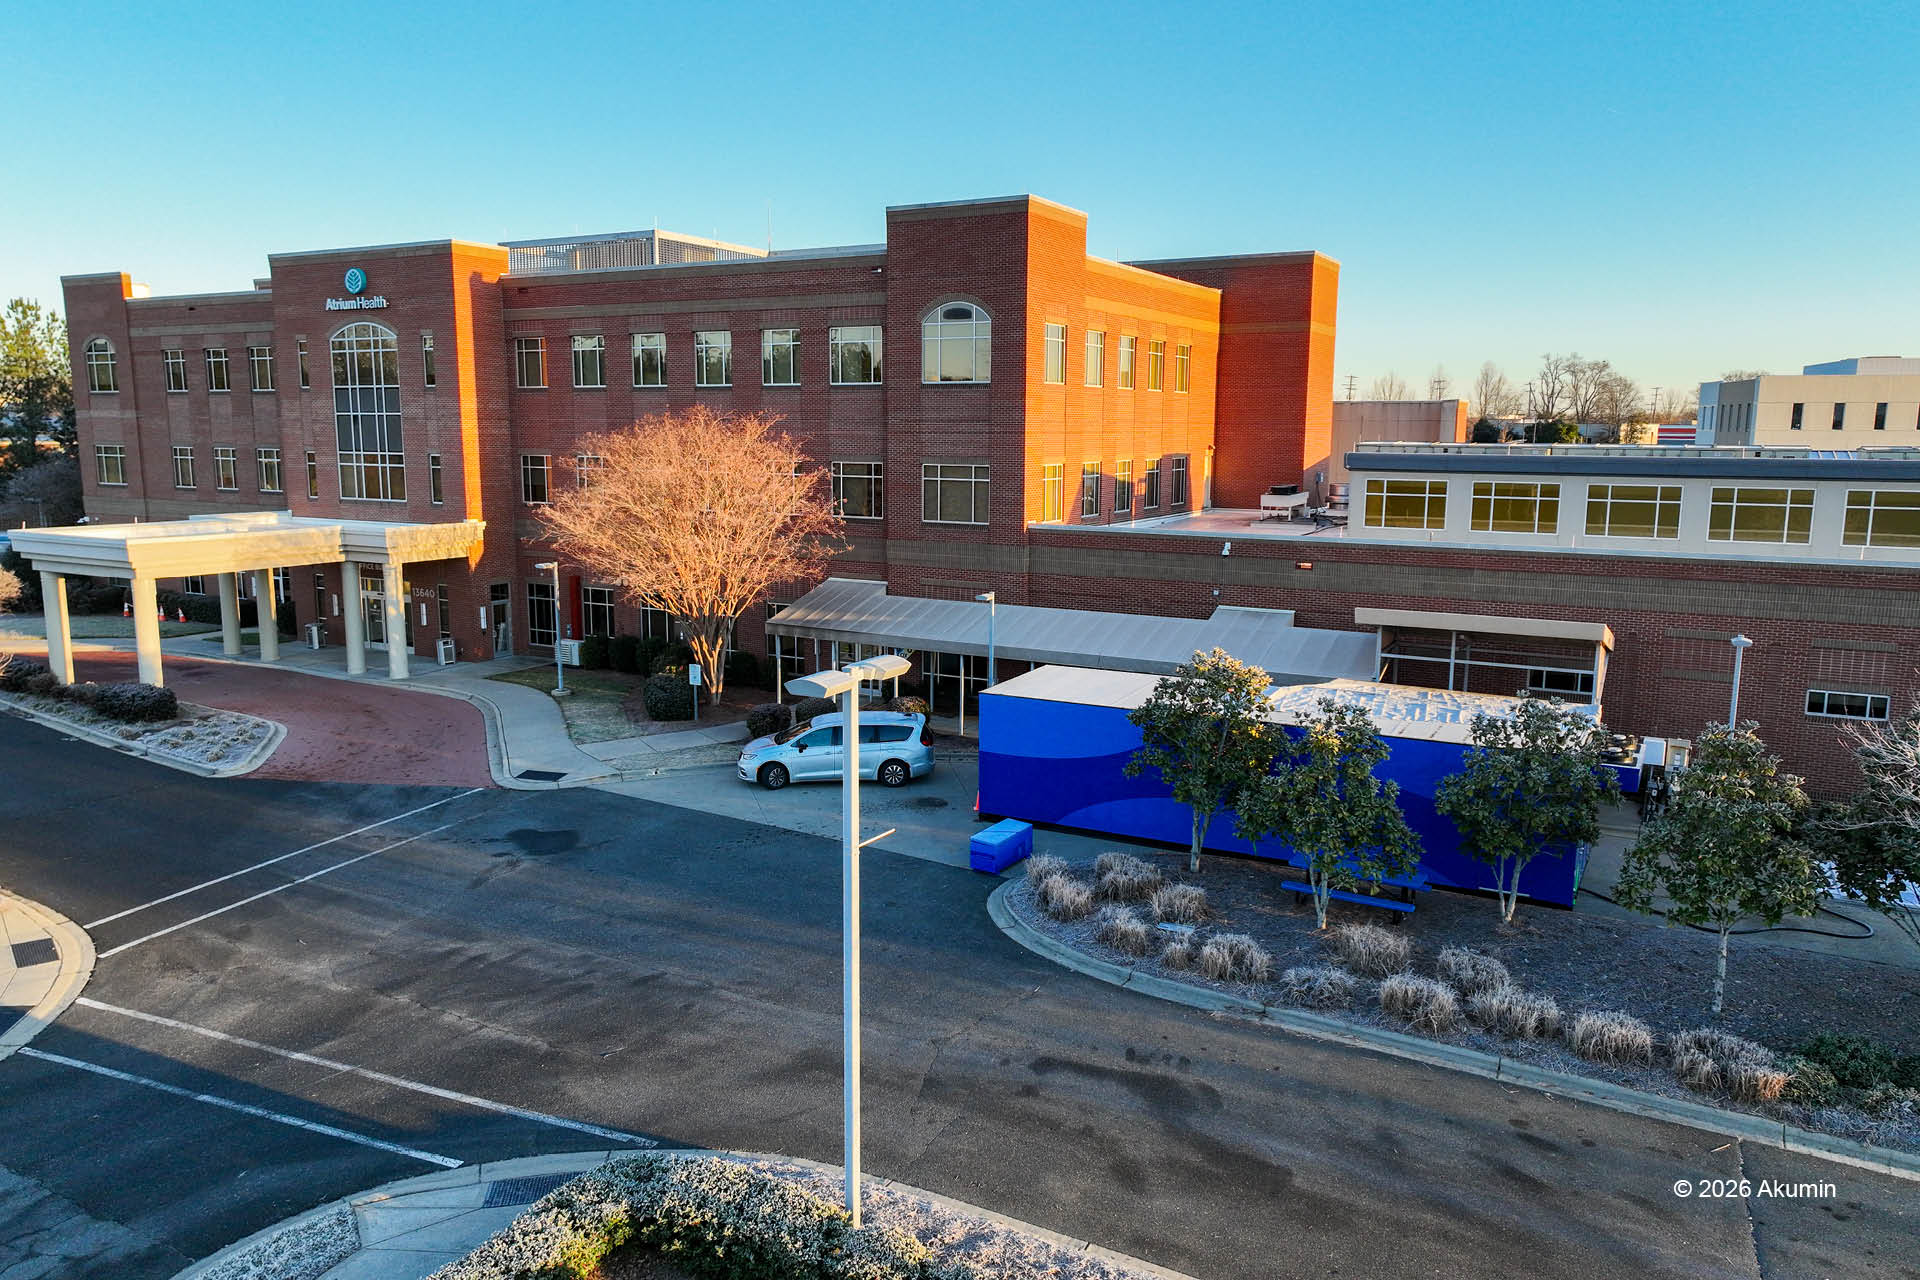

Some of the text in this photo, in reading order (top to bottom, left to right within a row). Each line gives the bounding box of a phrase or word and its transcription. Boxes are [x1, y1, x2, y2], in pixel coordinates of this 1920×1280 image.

[326, 296, 387, 310] Atrium Health
[412, 587, 435, 598] 13640
